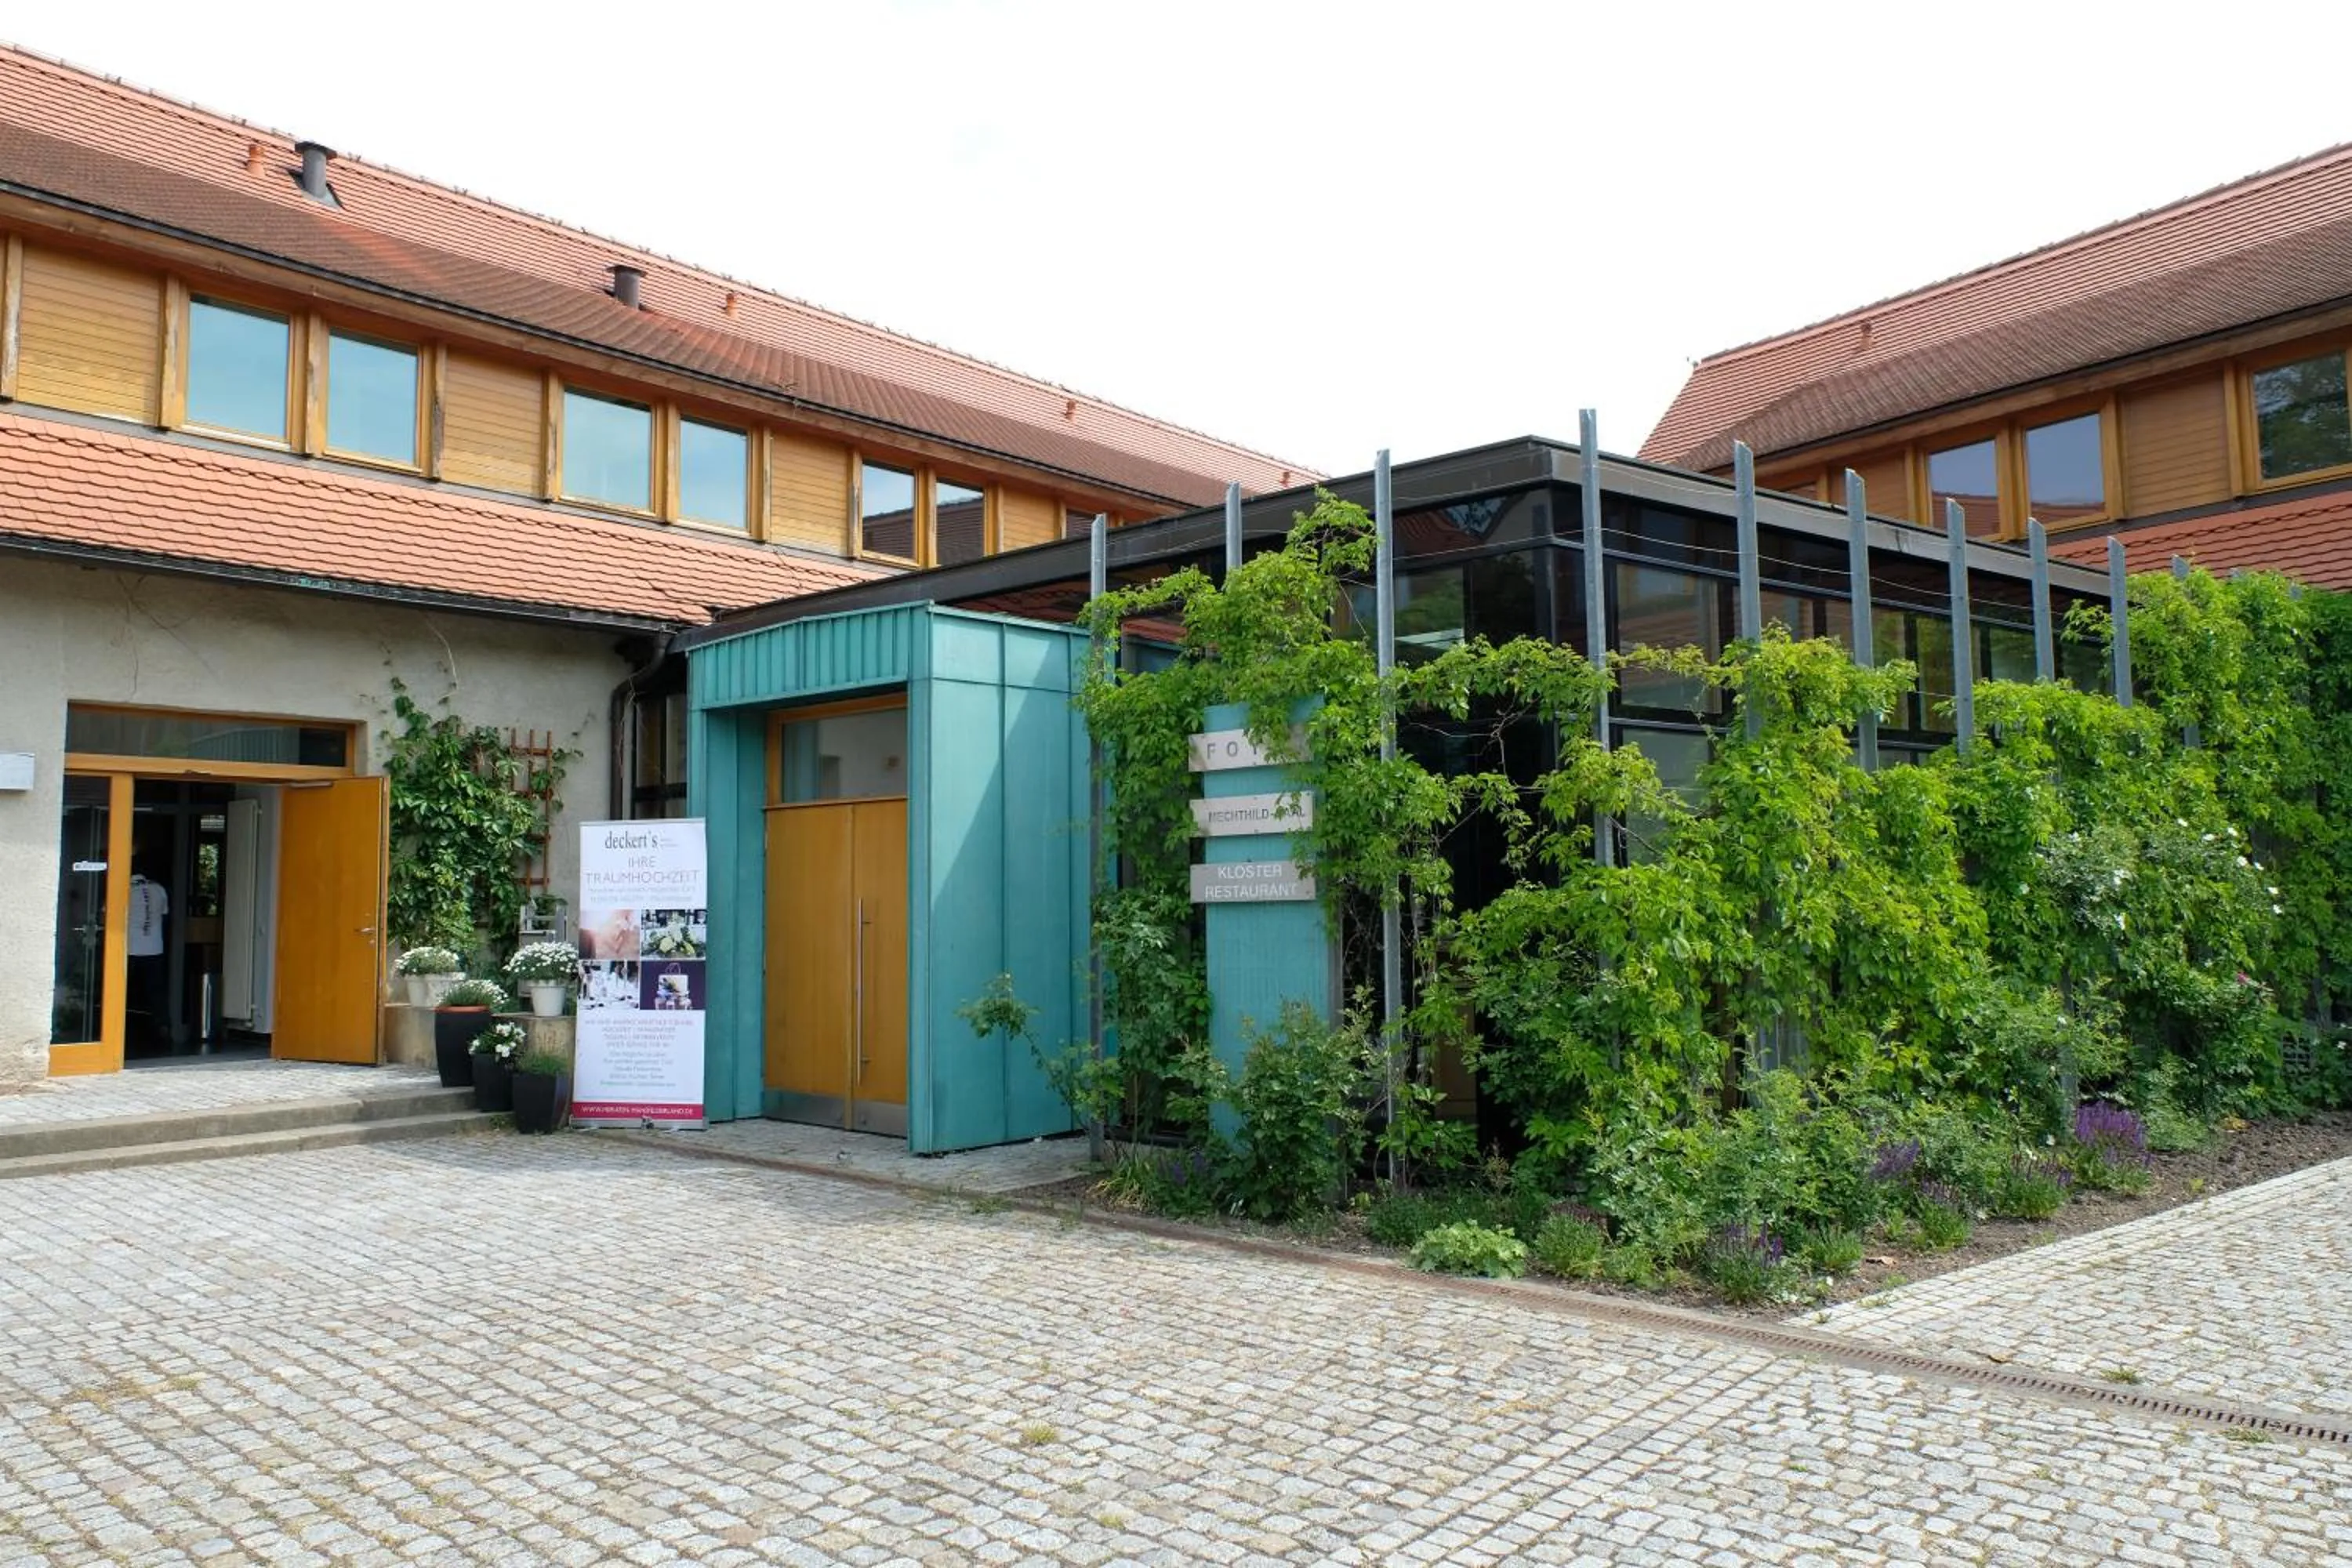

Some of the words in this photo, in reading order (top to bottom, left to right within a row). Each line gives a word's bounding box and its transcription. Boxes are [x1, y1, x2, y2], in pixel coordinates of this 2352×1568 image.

[1208, 808, 1306, 823] MECHTHILD-AAL
[604, 829, 659, 850] deckert's
[627, 855, 658, 868] IHRE
[585, 869, 701, 885] TRAUMHOCHZEIT
[1218, 865, 1283, 879] KLOSTER
[1205, 882, 1298, 898] RESTAURANT
